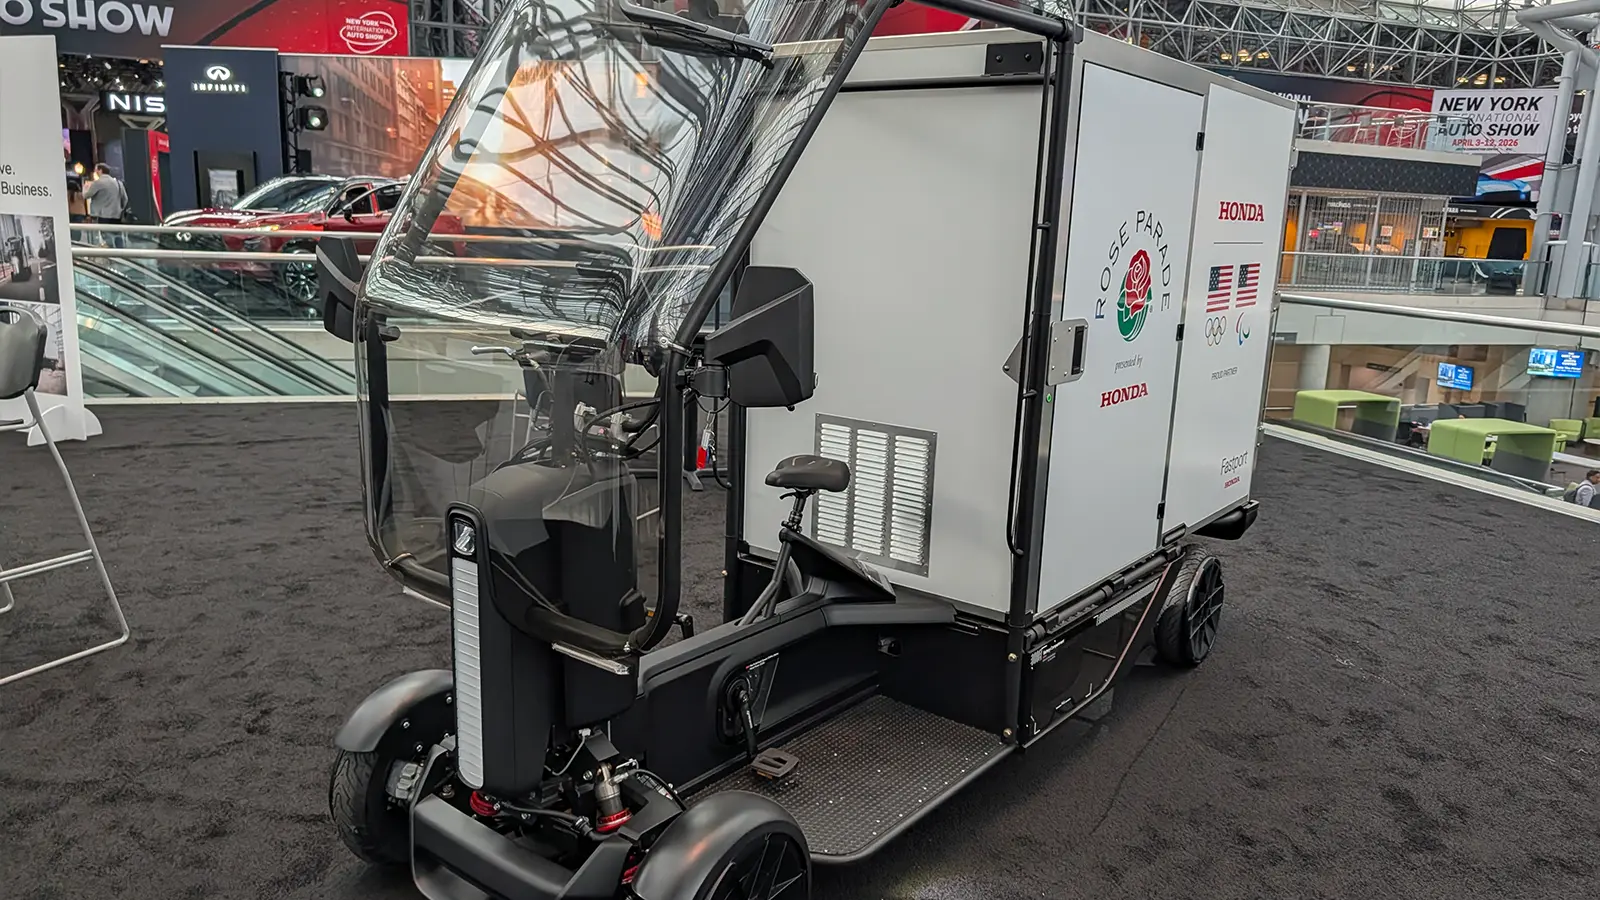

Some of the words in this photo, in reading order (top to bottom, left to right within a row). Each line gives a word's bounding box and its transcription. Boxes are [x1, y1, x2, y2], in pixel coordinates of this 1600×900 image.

[41, 0, 174, 36] SHOW
[362, 19, 379, 27] YORK
[346, 25, 393, 35] INTERNATIONAL
[193, 83, 246, 92] INFINITI
[1439, 97, 1485, 111] NEW
[1490, 96, 1544, 111] YORK
[1487, 123, 1540, 136] SHOW
[1452, 139, 1474, 147] APRIL
[1498, 138, 1518, 146] 2026
[1, 181, 52, 197] Business.
[1218, 201, 1264, 221] HONDA
[1095, 221, 1129, 319] ROSE
[1136, 210, 1171, 312] PARADE
[1114, 355, 1136, 373] presented
[1136, 354, 1143, 368] by
[1100, 382, 1148, 408] HONDA
[1220, 451, 1248, 475] Fastport
